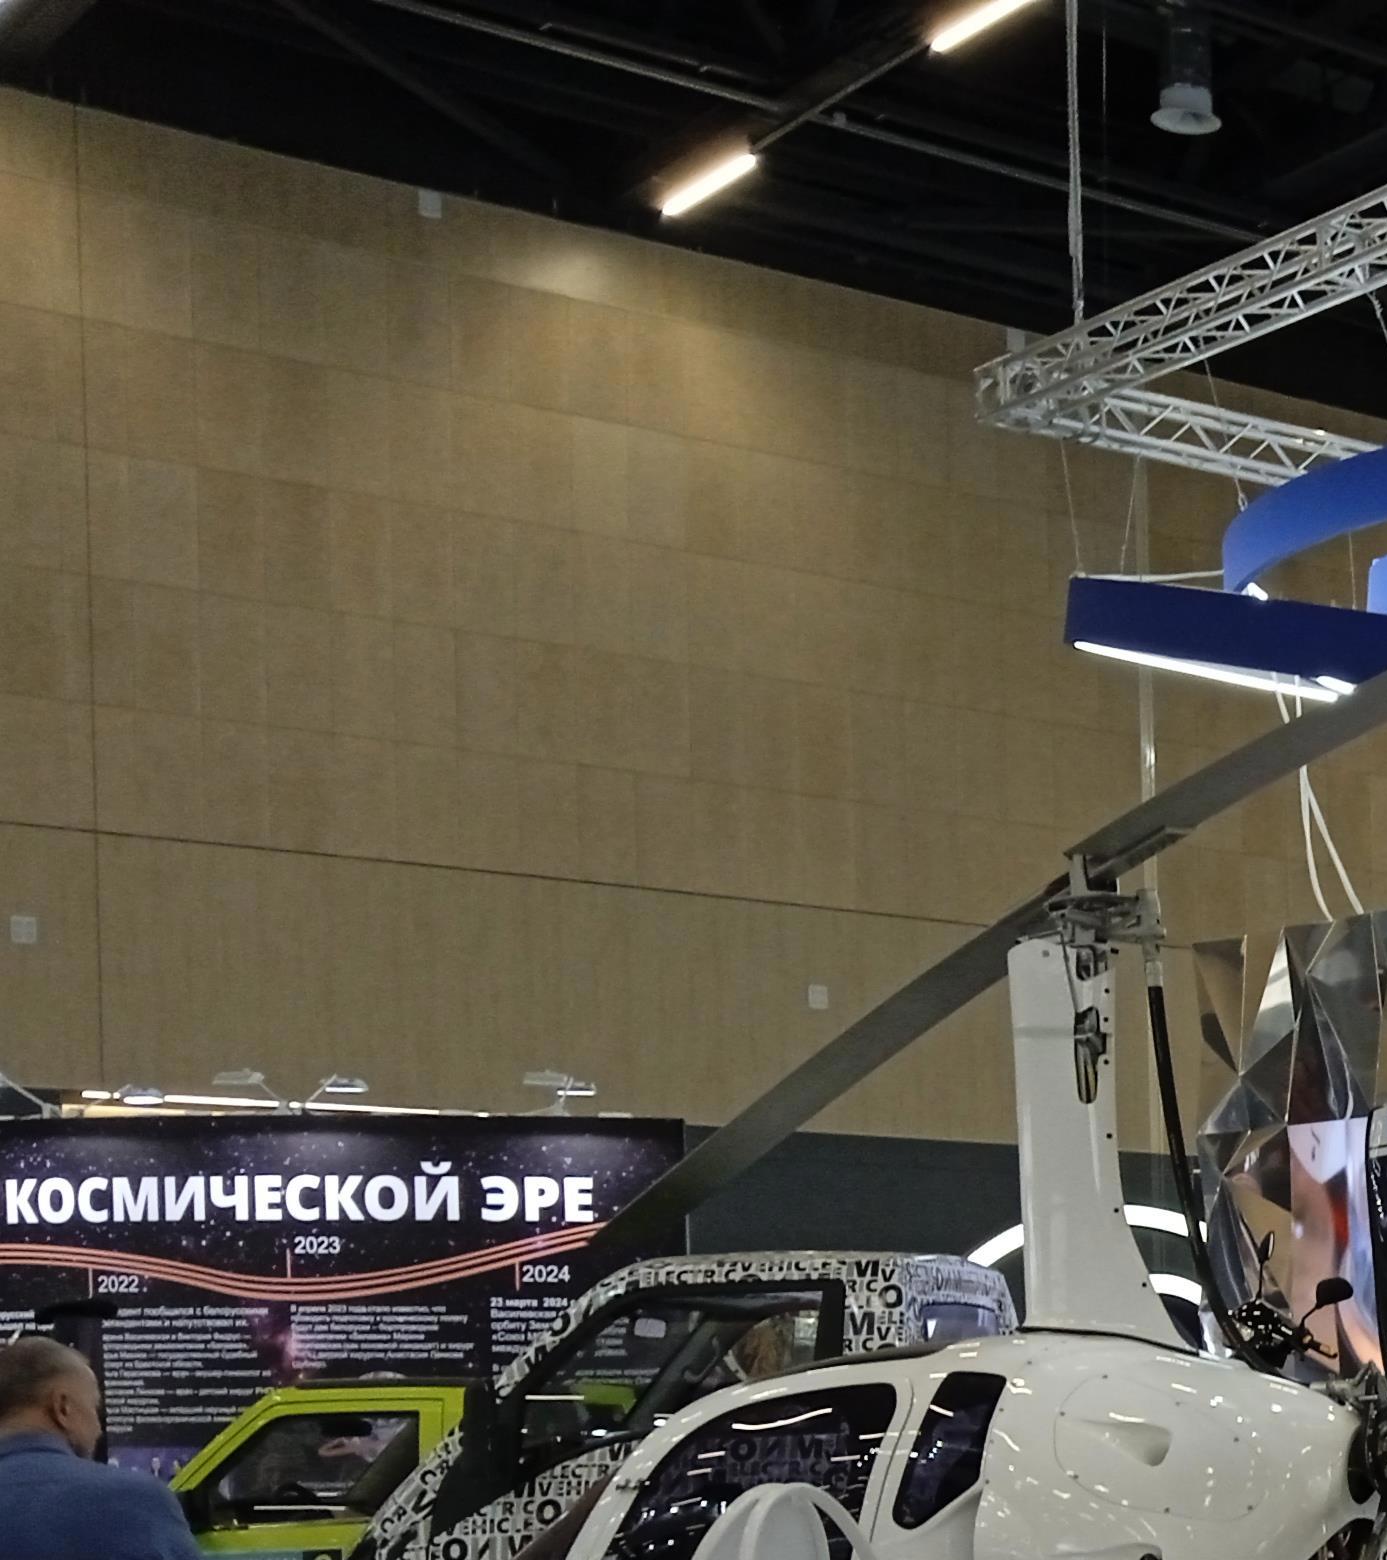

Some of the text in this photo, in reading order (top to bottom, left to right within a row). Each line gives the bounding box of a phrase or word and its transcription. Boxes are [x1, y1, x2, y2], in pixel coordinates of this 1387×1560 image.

[4, 1161, 595, 1226] КОСМИЧЕСКОЙ ЭРЕ
[293, 1235, 341, 1256] 2023
[521, 1264, 571, 1283] 2024
[97, 1275, 140, 1294] 2022
